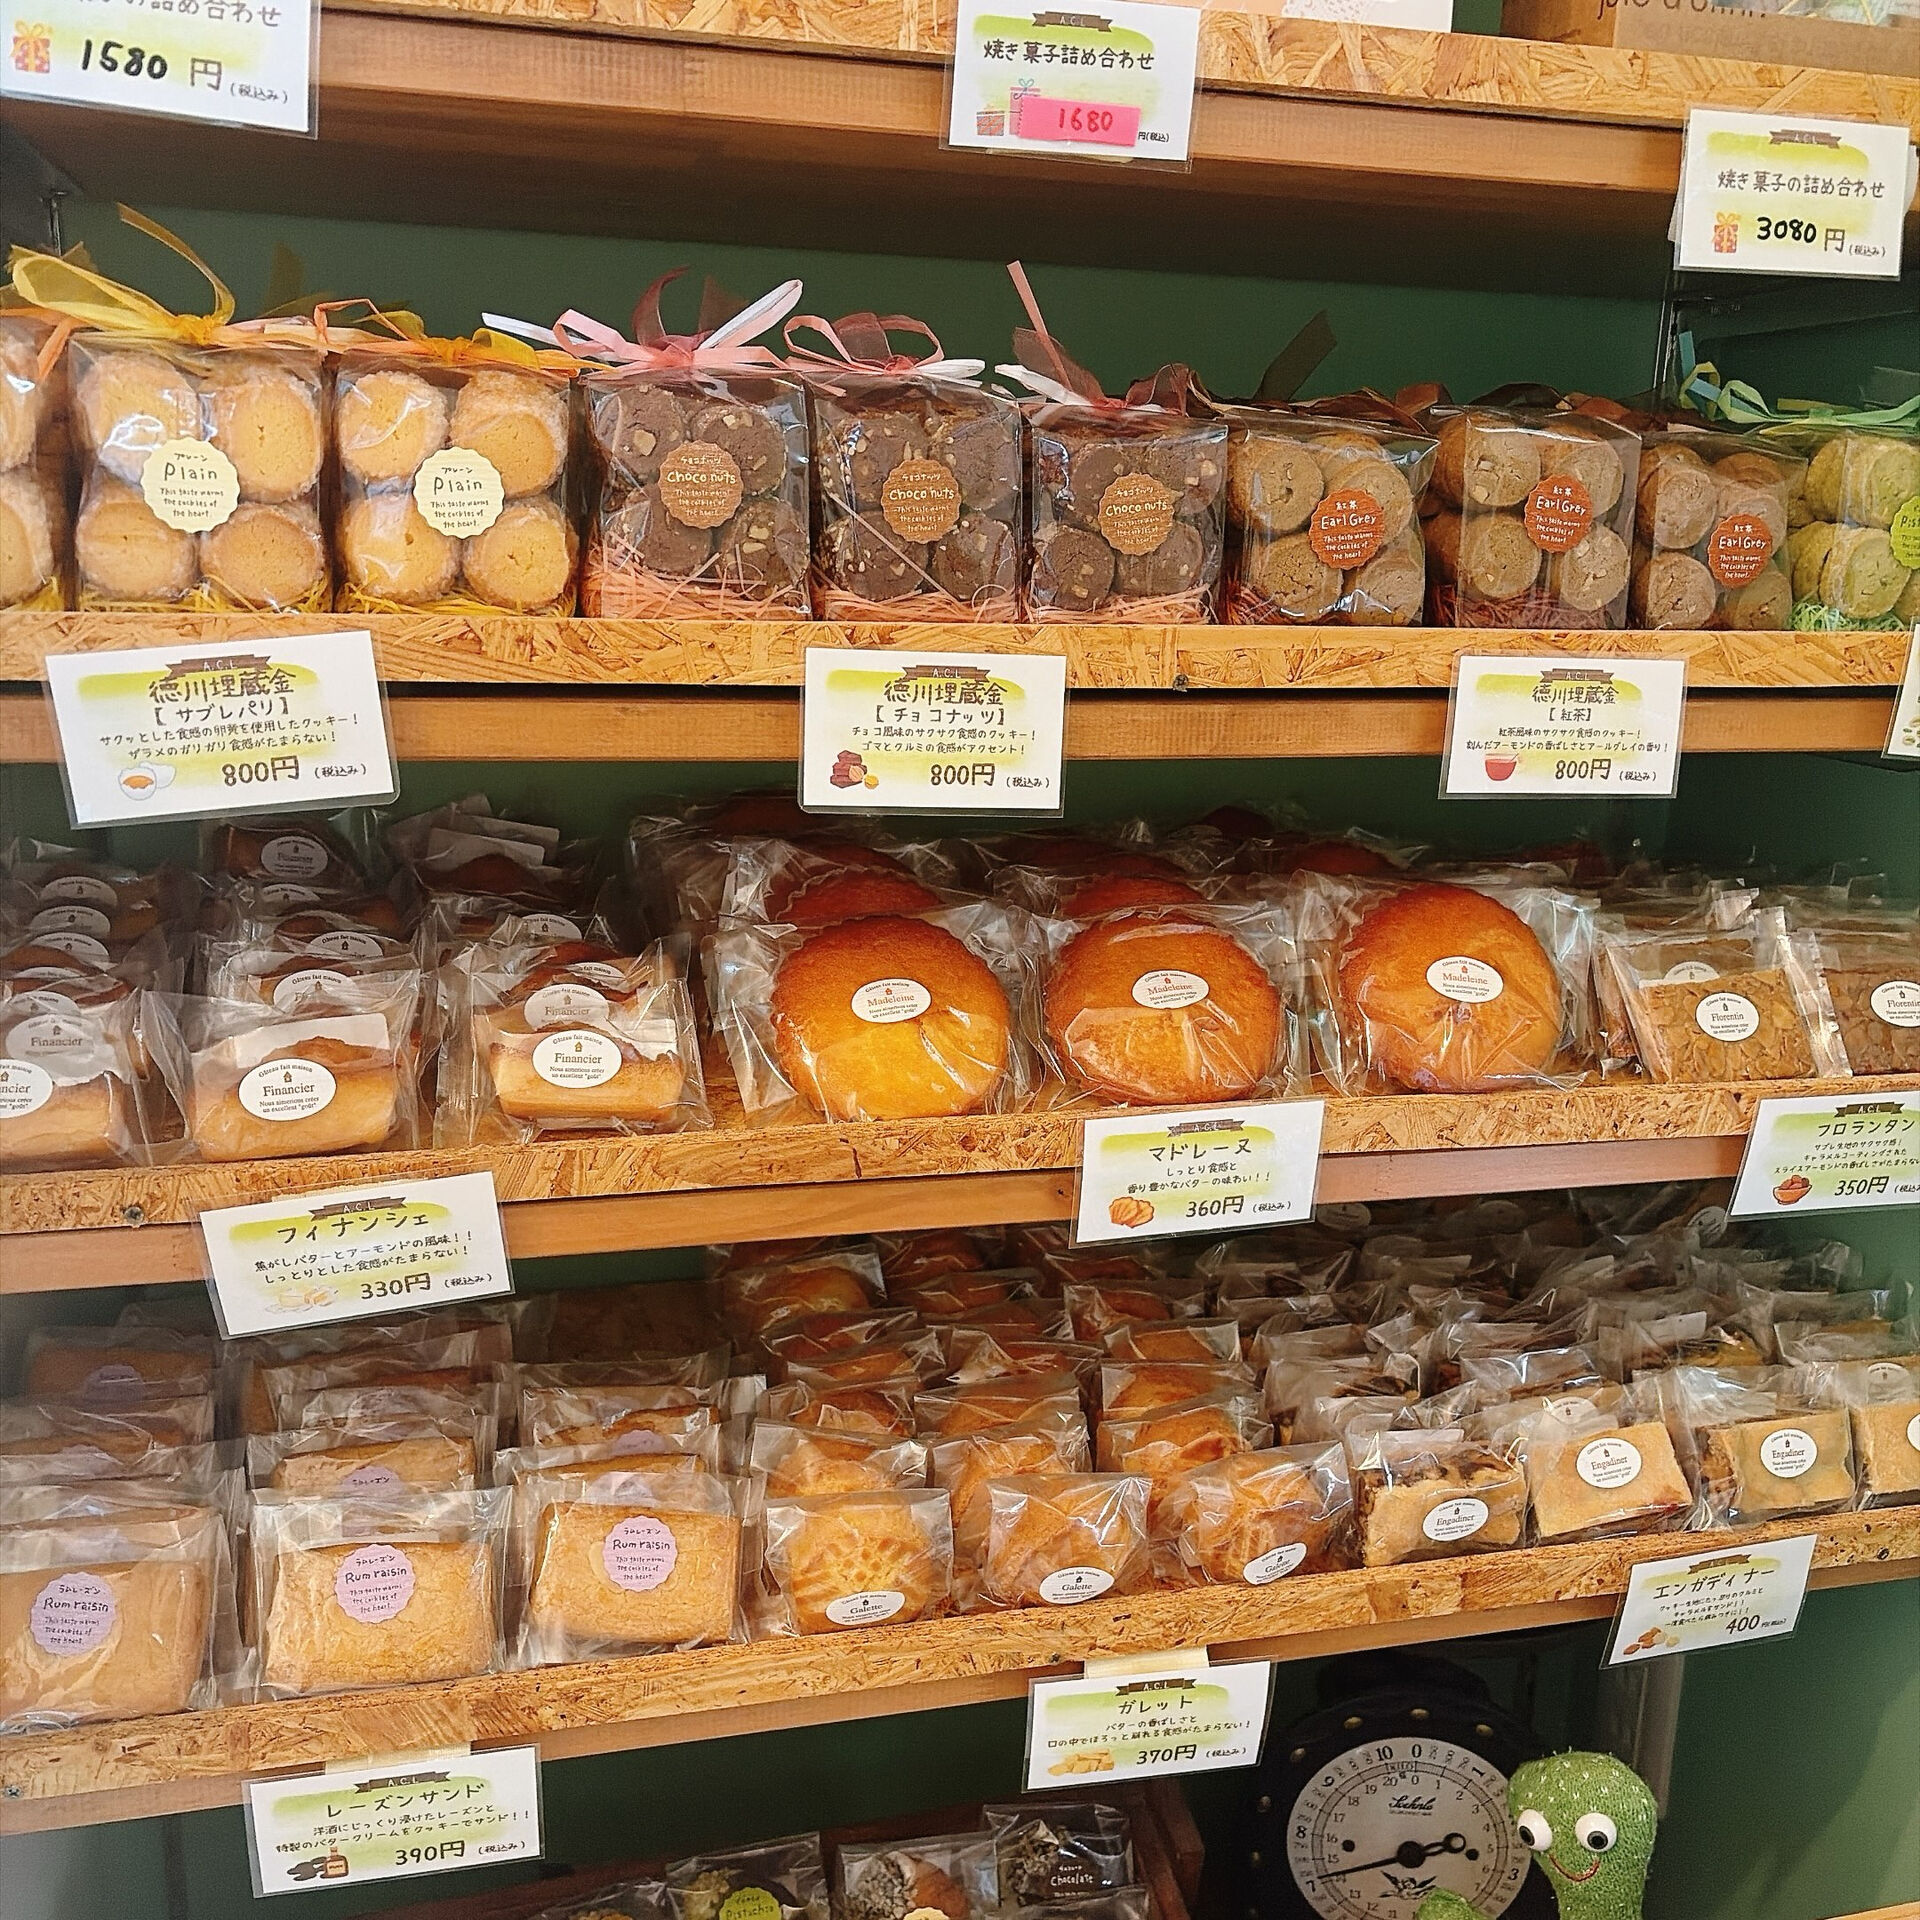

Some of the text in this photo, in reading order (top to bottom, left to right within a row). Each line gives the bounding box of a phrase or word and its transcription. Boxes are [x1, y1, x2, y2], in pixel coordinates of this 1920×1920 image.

[984, 39, 1155, 70] 焼き菓子詰め合わせ
[81, 39, 168, 79] 1580
[190, 57, 222, 91] 円
[1059, 107, 1113, 133] 1680
[1718, 169, 1885, 199] 焼き菓子の詰め合わせ
[1757, 216, 1817, 244] 3080
[1823, 228, 1846, 253] 円
[165, 462, 217, 480] Plain
[667, 471, 736, 484] Choco nuts
[434, 476, 482, 495] Plain
[890, 488, 954, 500] Choco nuts
[1106, 500, 1167, 516] Choco nuts
[1536, 496, 1586, 515] Earl Grey
[1321, 514, 1376, 530] Earl Grey
[1720, 536, 1766, 549] Earl Grey
[149, 667, 297, 704] 徳川埋蔵金
[884, 680, 1008, 706] 徳川埋蔵金
[1532, 685, 1619, 705] 徳川埋蔵金
[1549, 707, 1592, 722] 【紅茶】
[851, 727, 1036, 740] チョコ風味のサクサク食感のクッキー！
[222, 755, 367, 787] 800円 (税込み)
[930, 763, 1050, 789] 800円 (税込み)
[1555, 758, 1657, 781] 800円 (税込み)
[1443, 973, 1488, 984] Madeleine
[1148, 984, 1193, 995] Madeleine
[868, 995, 915, 1007] Madeleine
[545, 1006, 590, 1016] Financier
[1712, 1012, 1744, 1021] Florentin
[31, 1037, 82, 1046] Financier
[555, 1052, 602, 1064] Financier
[263, 1083, 315, 1096] Financier
[1817, 1118, 1915, 1137] フロランタン
[1148, 1138, 1253, 1162] マドレーヌ
[1166, 1162, 1237, 1177] しっとり食感と
[1834, 1175, 1890, 1196] 350円
[1186, 1195, 1292, 1218] 360円 (税込み)
[277, 1210, 430, 1244] フィナンシェ
[361, 1273, 493, 1300] 330円 (税込み)
[1772, 1449, 1804, 1460] Engadiner
[1591, 1457, 1627, 1470] Engadiner
[1437, 1515, 1475, 1526] Engadiner
[613, 1539, 670, 1550] Rum raisin
[345, 1568, 407, 1584] Rum raisin
[1653, 1567, 1775, 1600] エンガディナー
[44, 1597, 109, 1612] Rum raisin
[850, 1604, 883, 1614] Galette
[1726, 1614, 1761, 1635] 400
[1118, 1695, 1193, 1715] ガレット
[1105, 1715, 1197, 1731] バターの香ばしさと
[1136, 1743, 1197, 1766] 370円
[1376, 1746, 1393, 1761] 10
[1412, 1744, 1422, 1758] 0
[1322, 1776, 1335, 1787] 9
[1383, 1776, 1398, 1786] 20
[1412, 1775, 1419, 1785] 0
[1365, 1785, 1377, 1794] 19
[1456, 1791, 1463, 1800] 2
[327, 1783, 484, 1818] レーズンサンド
[1348, 1796, 1360, 1806] 18
[1472, 1804, 1479, 1814] 3
[1334, 1813, 1345, 1822] 17
[1296, 1825, 1307, 1839] 8
[395, 1840, 526, 1866] 390円 (税込み)
[1051, 1873, 1094, 1886] Chocolate
[1508, 1868, 1519, 1880] 3
[1305, 1880, 1316, 1892] 7
